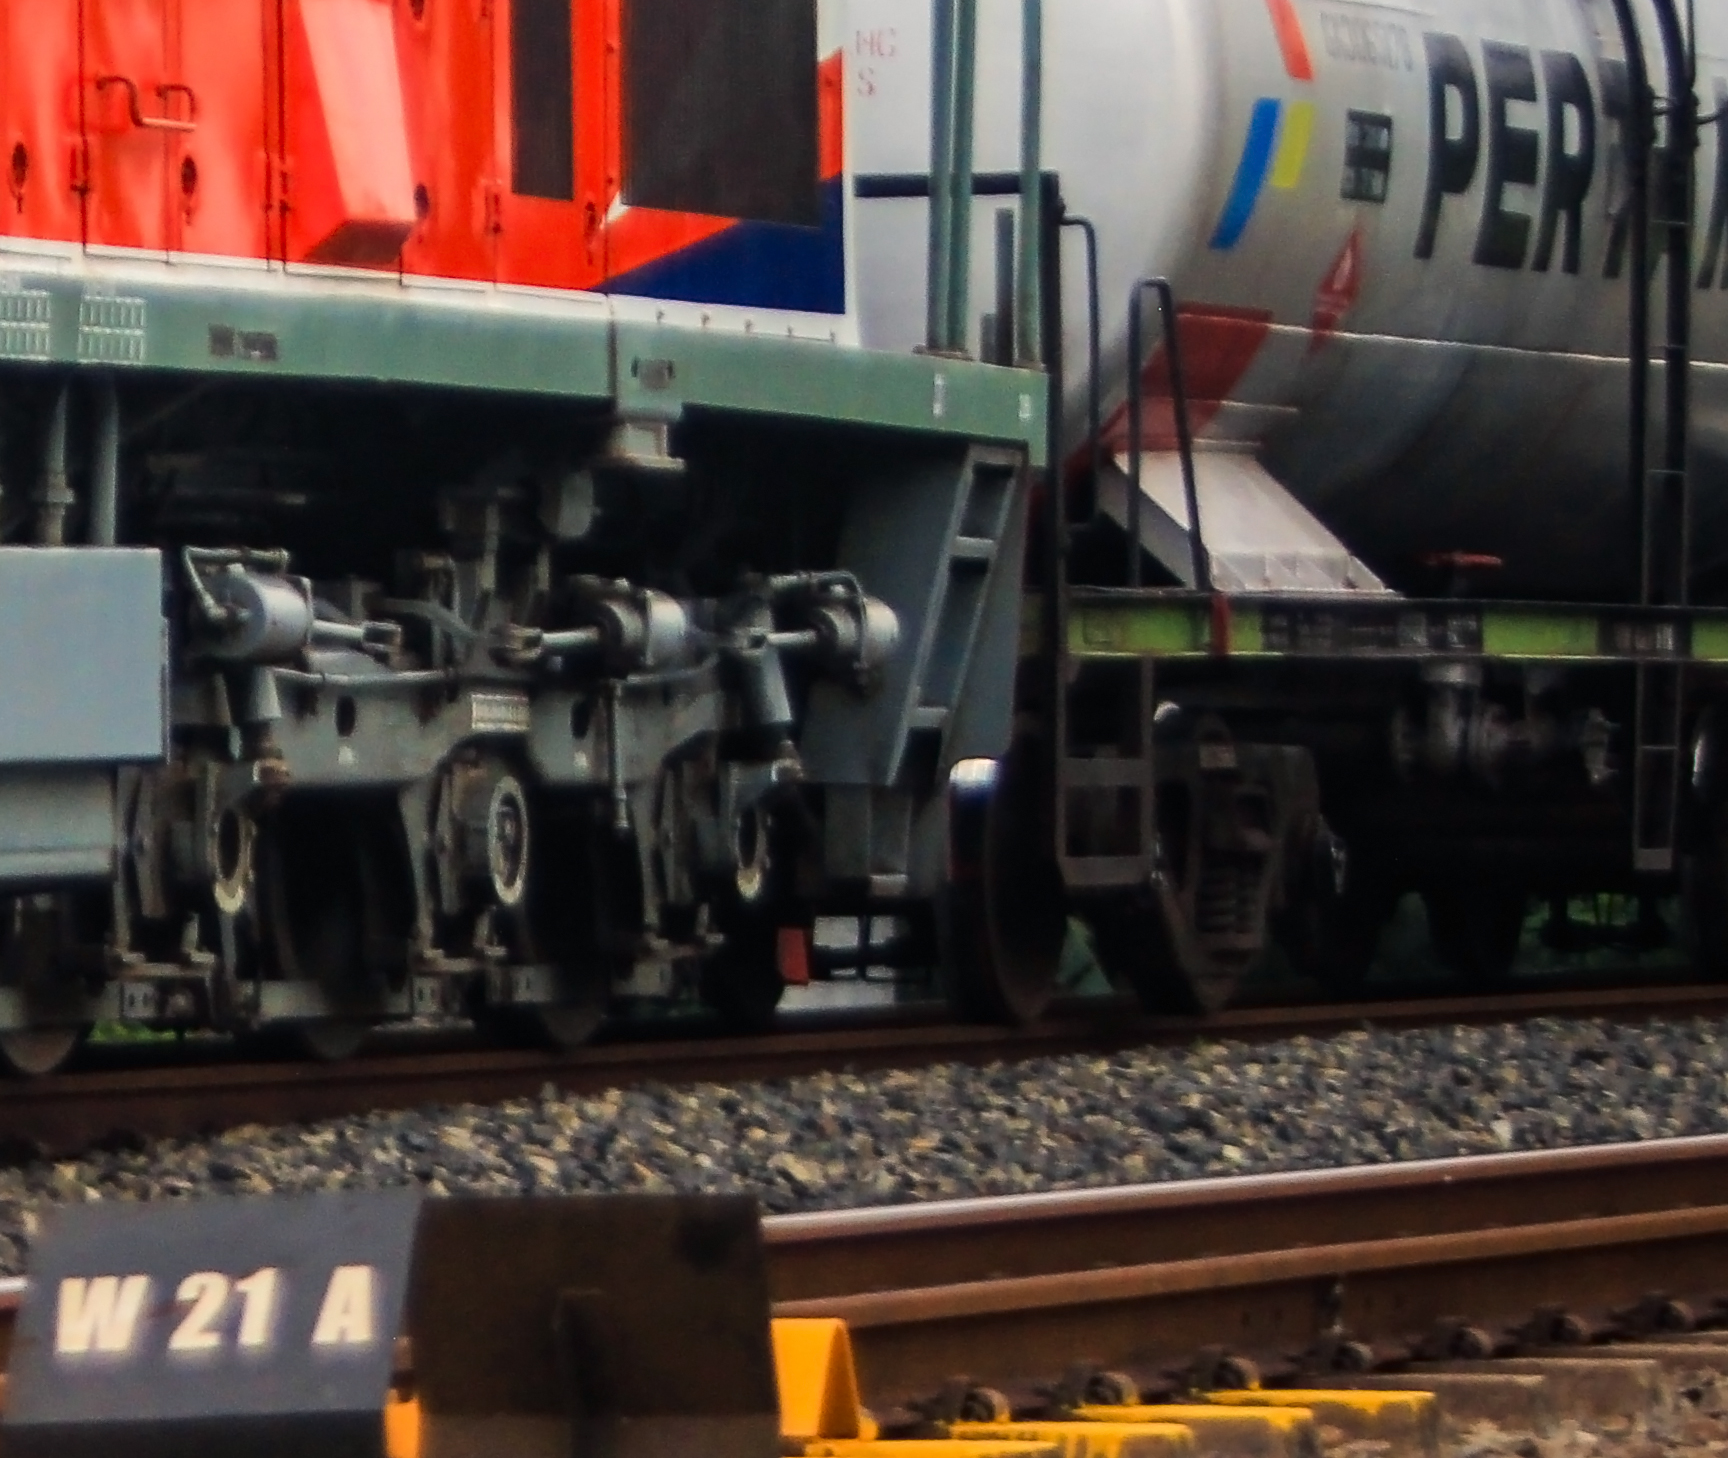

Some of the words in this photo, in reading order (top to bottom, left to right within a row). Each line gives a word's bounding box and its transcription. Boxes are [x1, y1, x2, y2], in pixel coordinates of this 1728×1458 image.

[56, 1274, 151, 1353] W
[168, 1266, 281, 1351] 21
[311, 1263, 374, 1345] A
